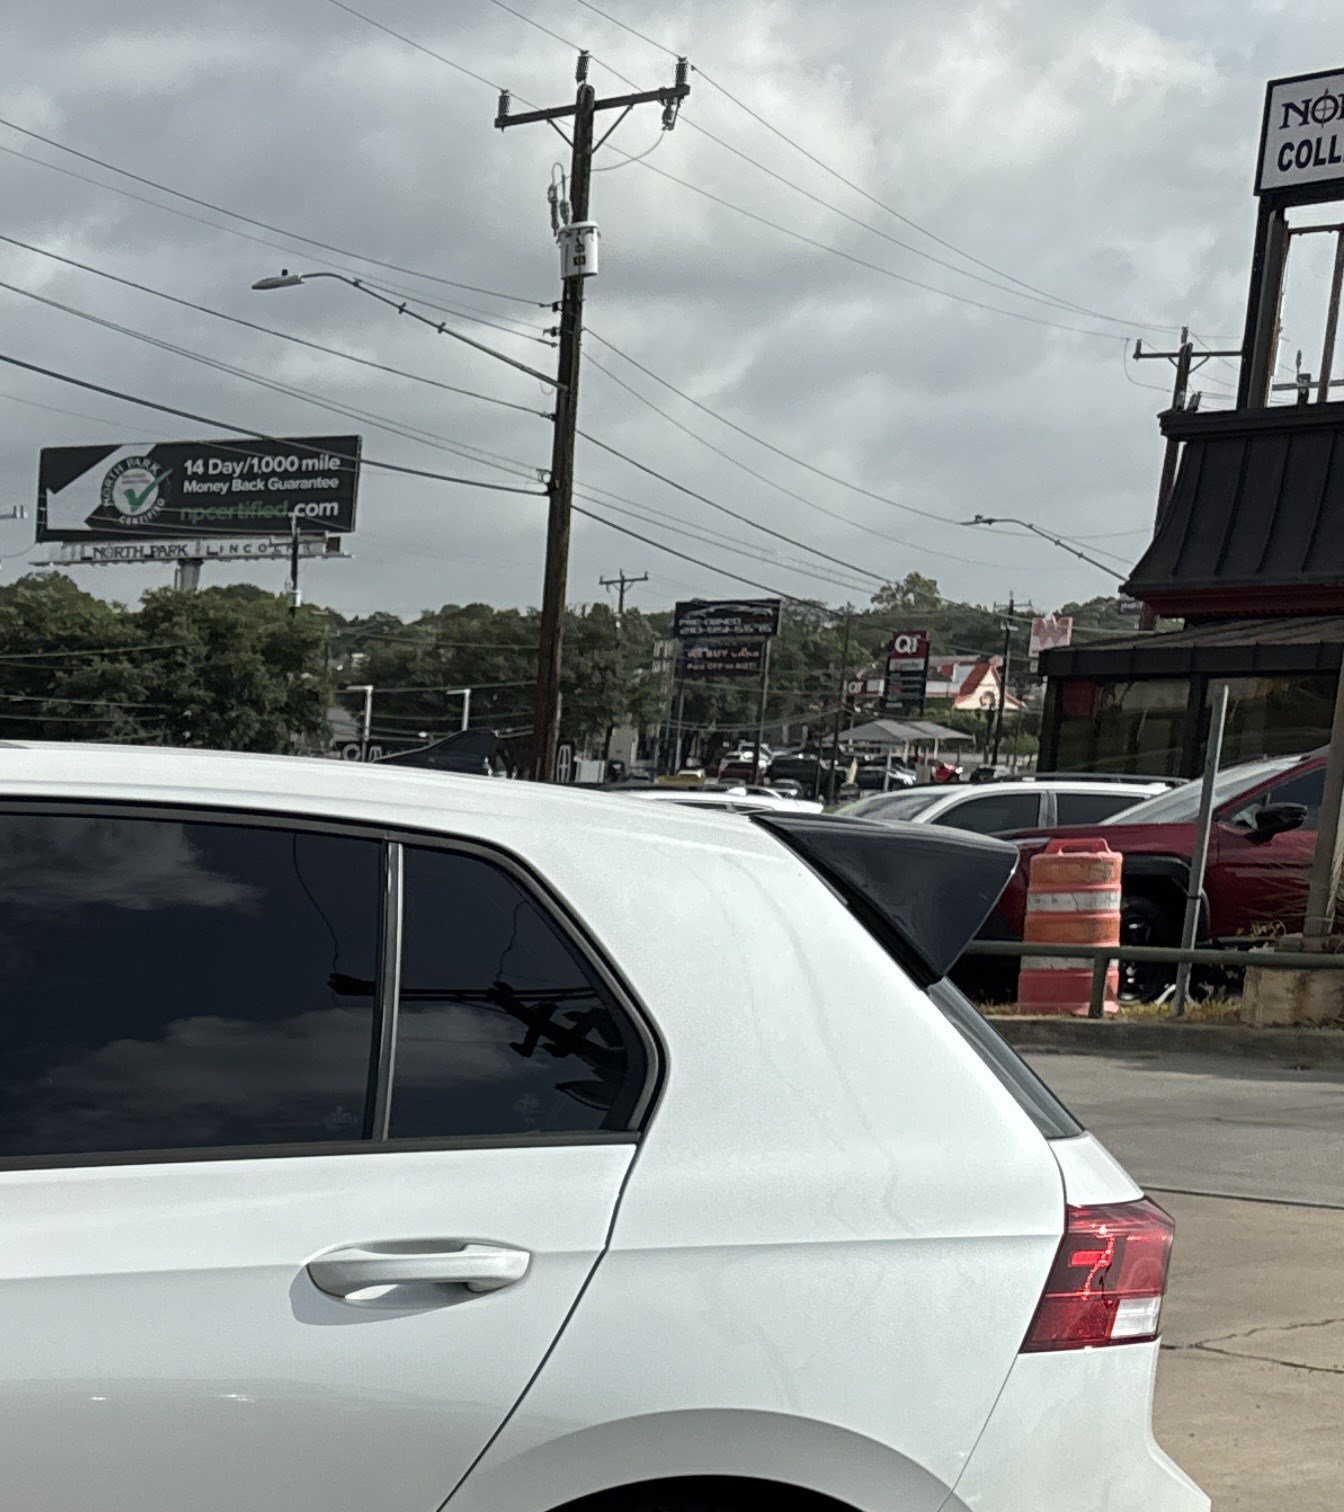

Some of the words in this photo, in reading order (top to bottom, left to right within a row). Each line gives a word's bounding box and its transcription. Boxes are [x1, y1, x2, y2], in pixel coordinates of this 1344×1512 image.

[1277, 134, 1344, 172] COLL
[183, 459, 205, 476] 14
[302, 453, 341, 471] mile
[183, 479, 230, 495] Money
[231, 478, 266, 492] Back
[267, 476, 339, 491] Guarantee
[93, 546, 145, 559] NORTH
[150, 544, 190, 558] PARK
